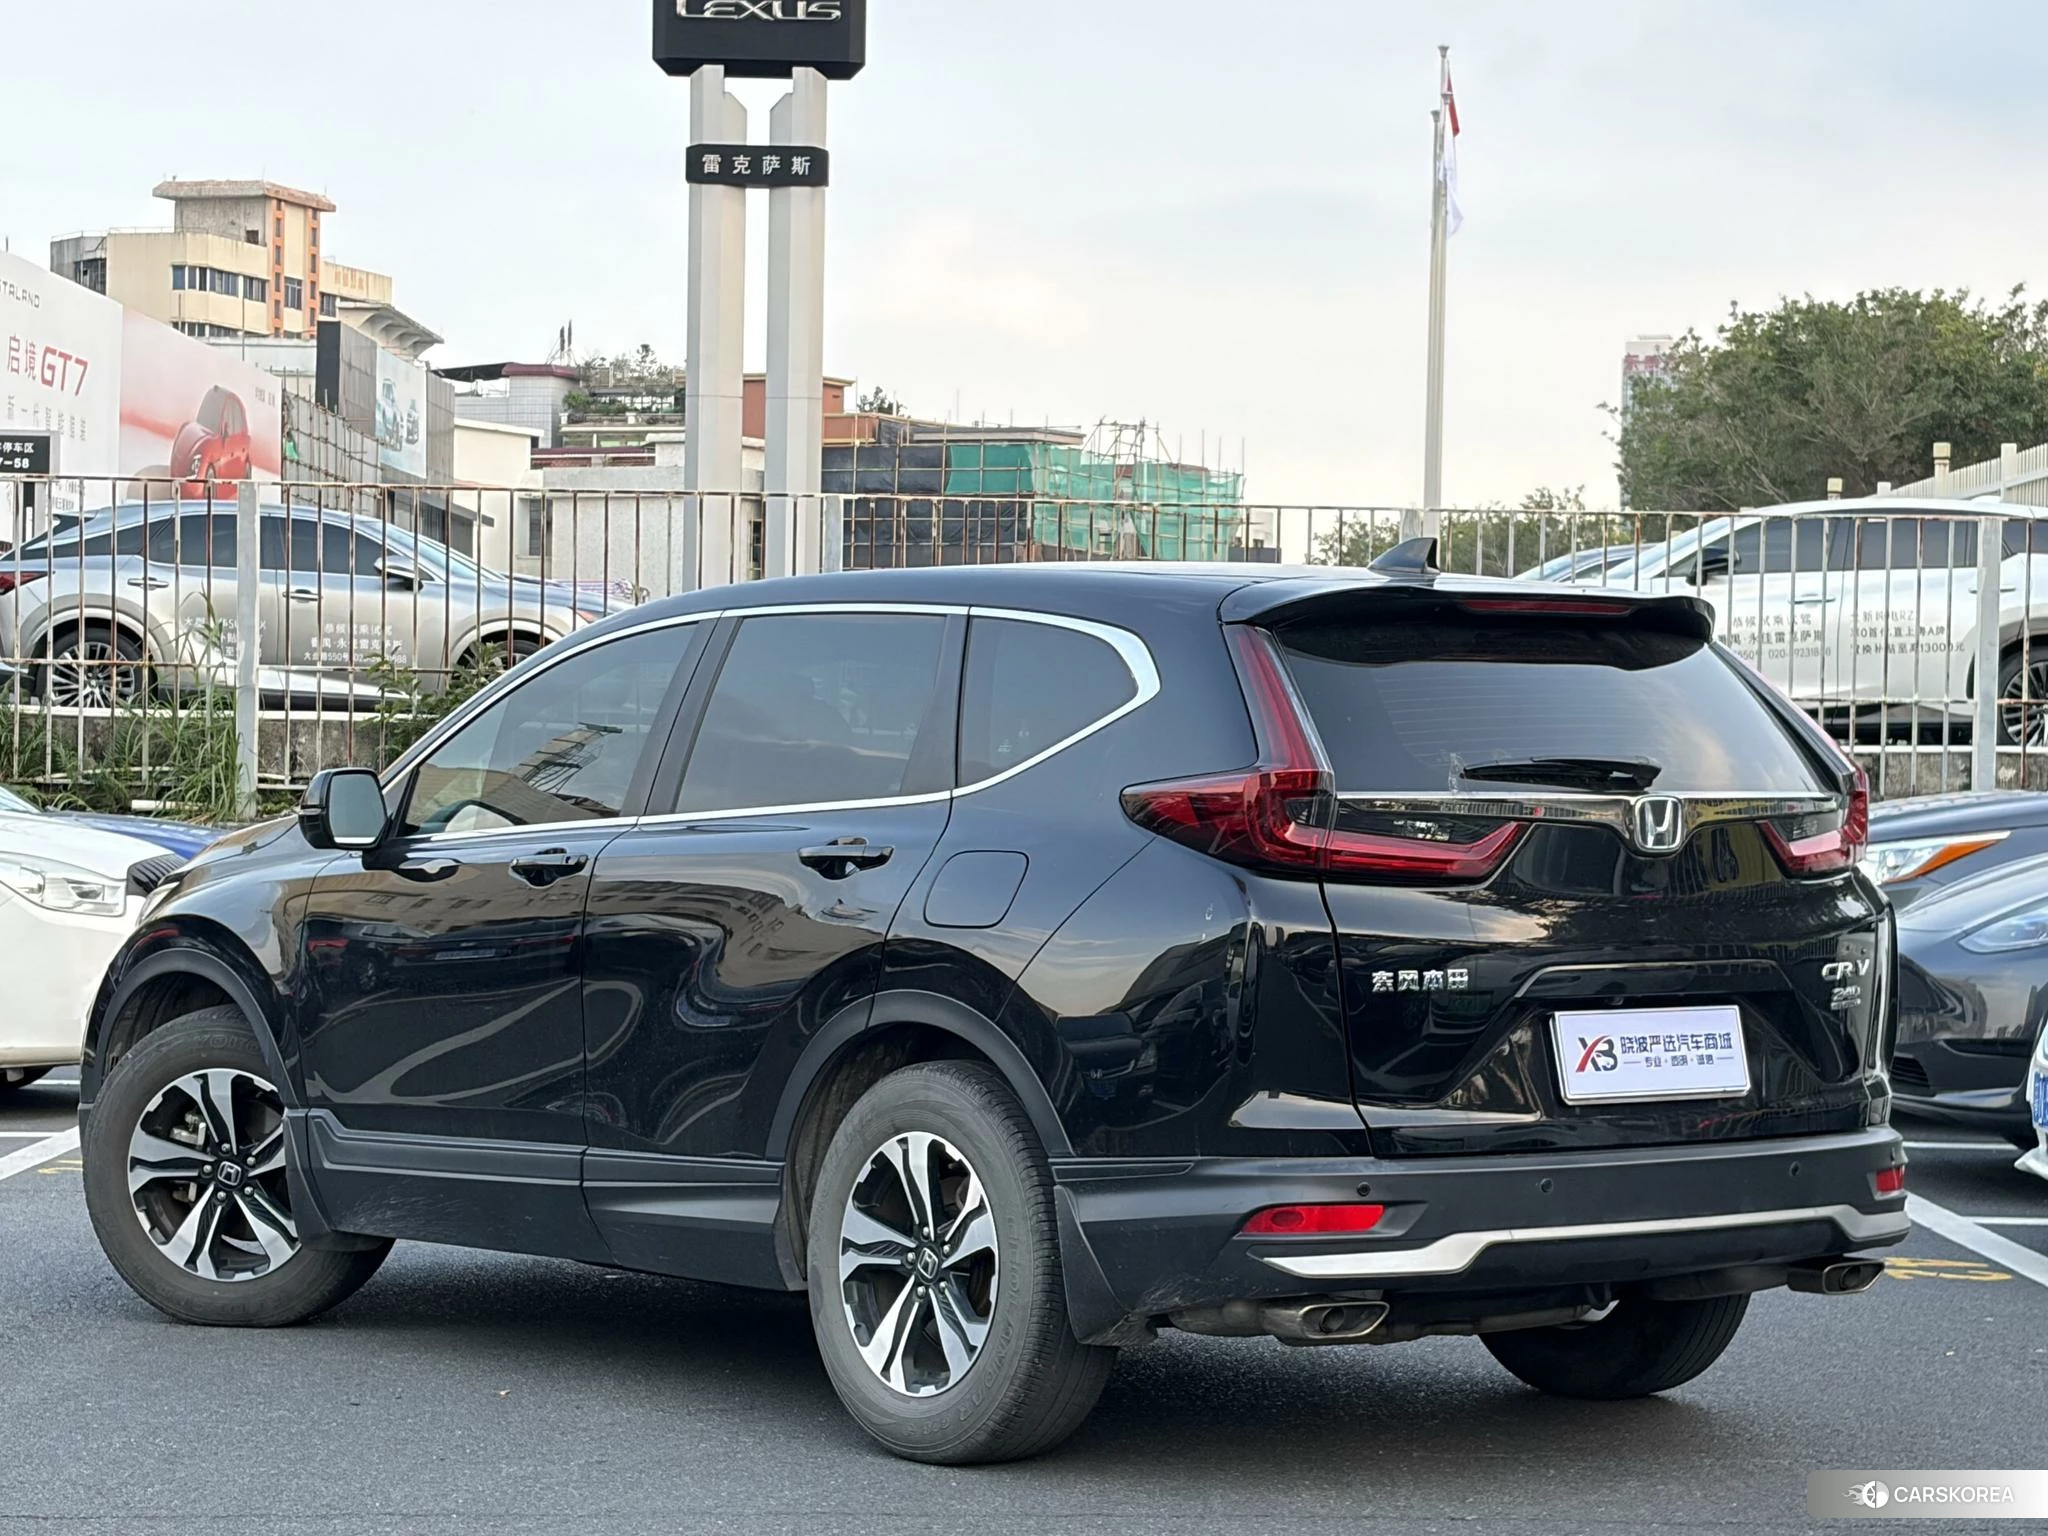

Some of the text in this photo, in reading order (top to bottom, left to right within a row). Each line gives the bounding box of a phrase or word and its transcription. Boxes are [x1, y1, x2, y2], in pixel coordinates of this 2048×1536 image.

[676, 0, 842, 20] LEXUS
[702, 154, 811, 176] 雷克萨斯
[0, 279, 40, 308] TALAND
[0, 442, 34, 453] 停车区
[1372, 969, 1469, 993] 东风本田
[1620, 1032, 1733, 1054] 晓波严选汽车商城
